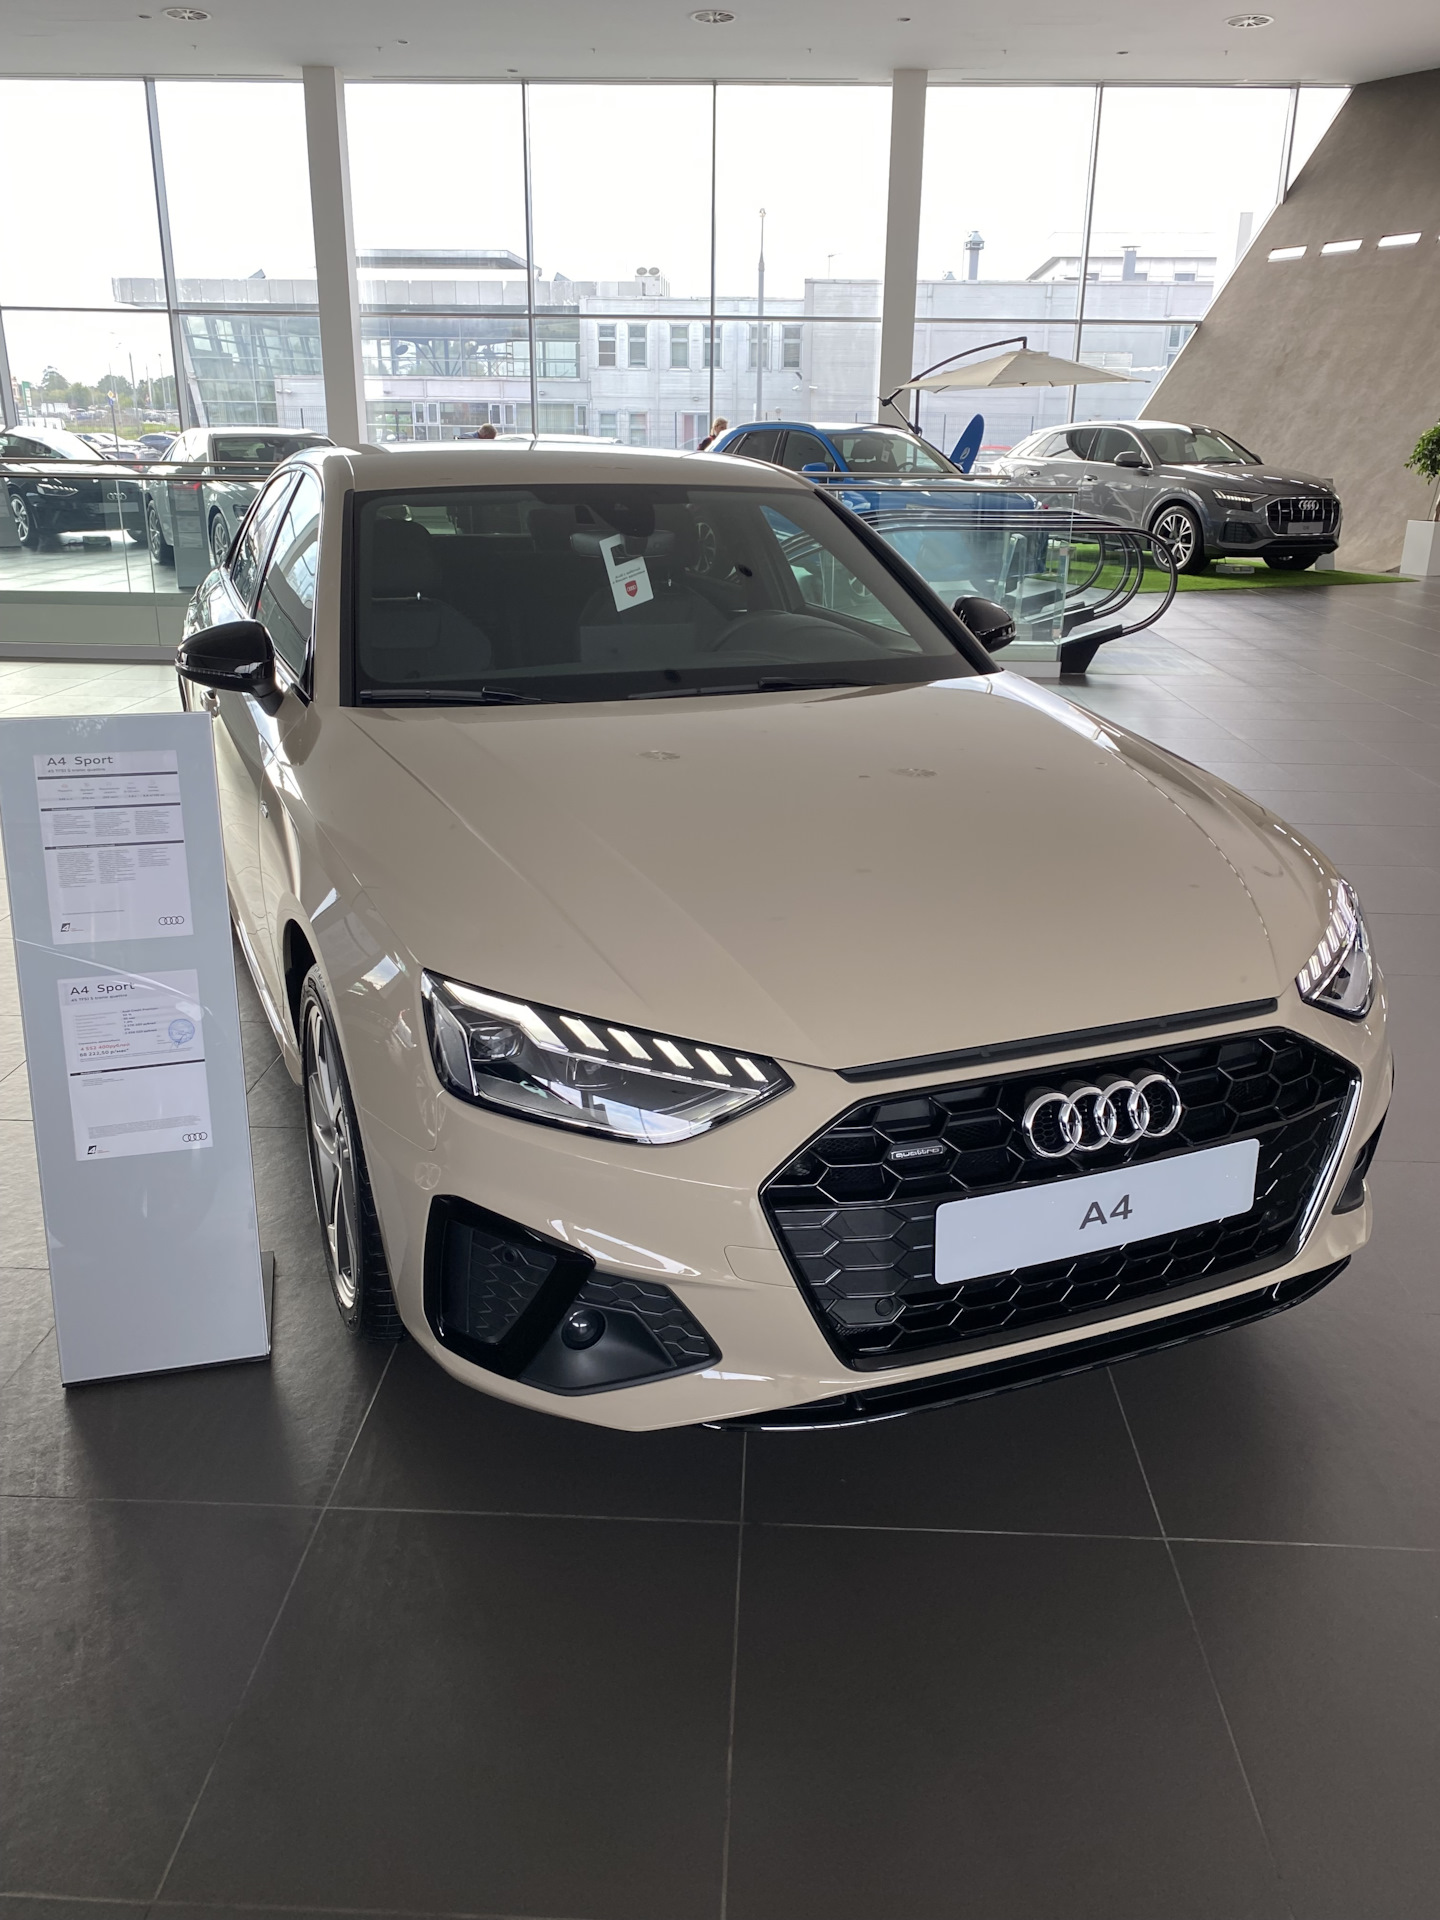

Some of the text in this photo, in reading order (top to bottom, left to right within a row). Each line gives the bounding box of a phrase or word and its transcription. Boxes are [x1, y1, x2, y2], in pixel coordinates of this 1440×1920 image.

[47, 756, 114, 767] A4 Sport
[70, 982, 135, 996] A4 Sport
[895, 1147, 940, 1159] quattro
[1079, 1193, 1134, 1230] A4
